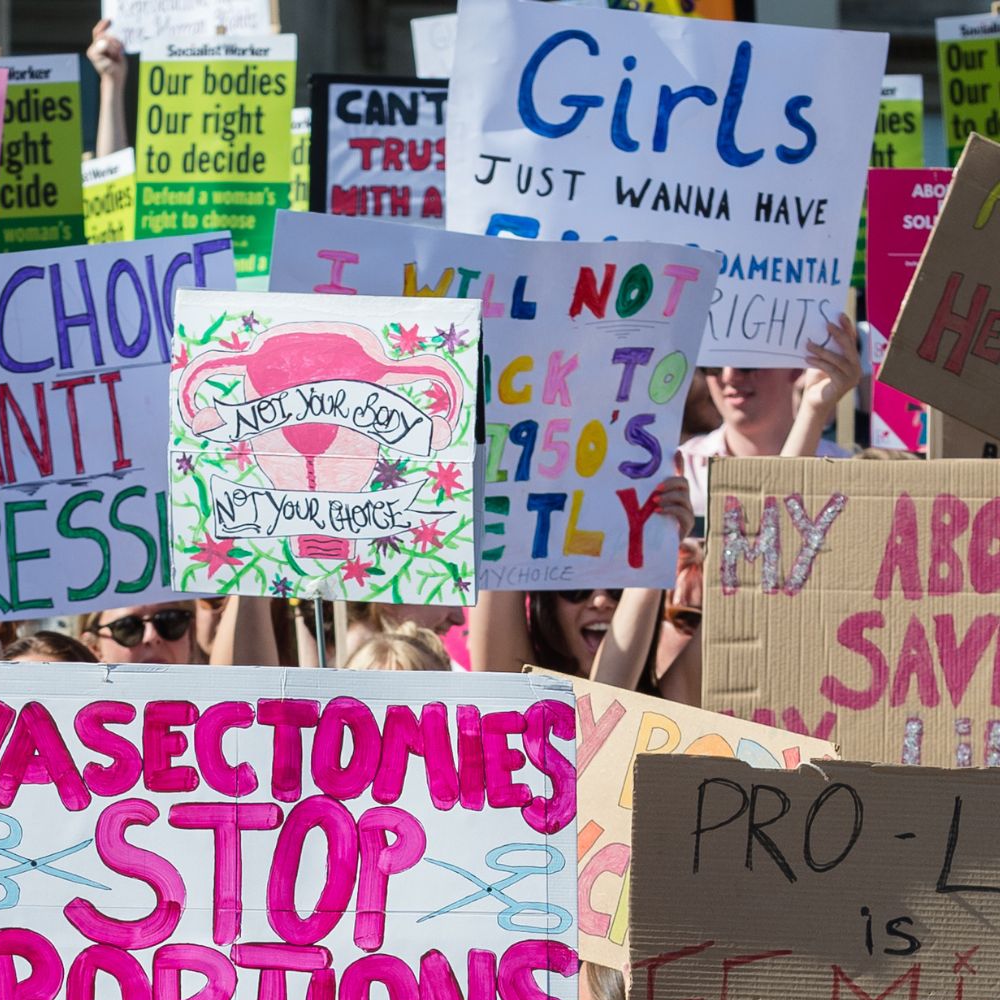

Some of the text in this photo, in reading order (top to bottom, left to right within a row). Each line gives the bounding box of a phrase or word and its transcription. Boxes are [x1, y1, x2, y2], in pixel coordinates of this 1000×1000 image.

[148, 63, 286, 97] Our bodies
[946, 42, 987, 72] Our
[516, 28, 818, 169] Girls
[947, 79, 989, 106] Our
[147, 104, 264, 142] Our right
[145, 147, 172, 174] to
[182, 144, 265, 174] decide
[142, 186, 195, 206] Defend
[198, 190, 208, 205] a
[211, 187, 276, 206] woman's
[331, 184, 411, 217] WITH
[420, 186, 443, 219] A
[474, 153, 828, 228] JUST WANNA HAVE
[141, 210, 256, 234] right to choose
[313, 248, 699, 321] I WILL NOT
[611, 346, 689, 405] TO
[229, 387, 424, 445] NOT YOUR BODY
[215, 487, 268, 525] NOT
[266, 490, 326, 536] YOUR
[719, 491, 850, 597] MY
[820, 609, 1000, 712] SAV
[62, 793, 427, 954] STOP
[859, 906, 922, 957] is
